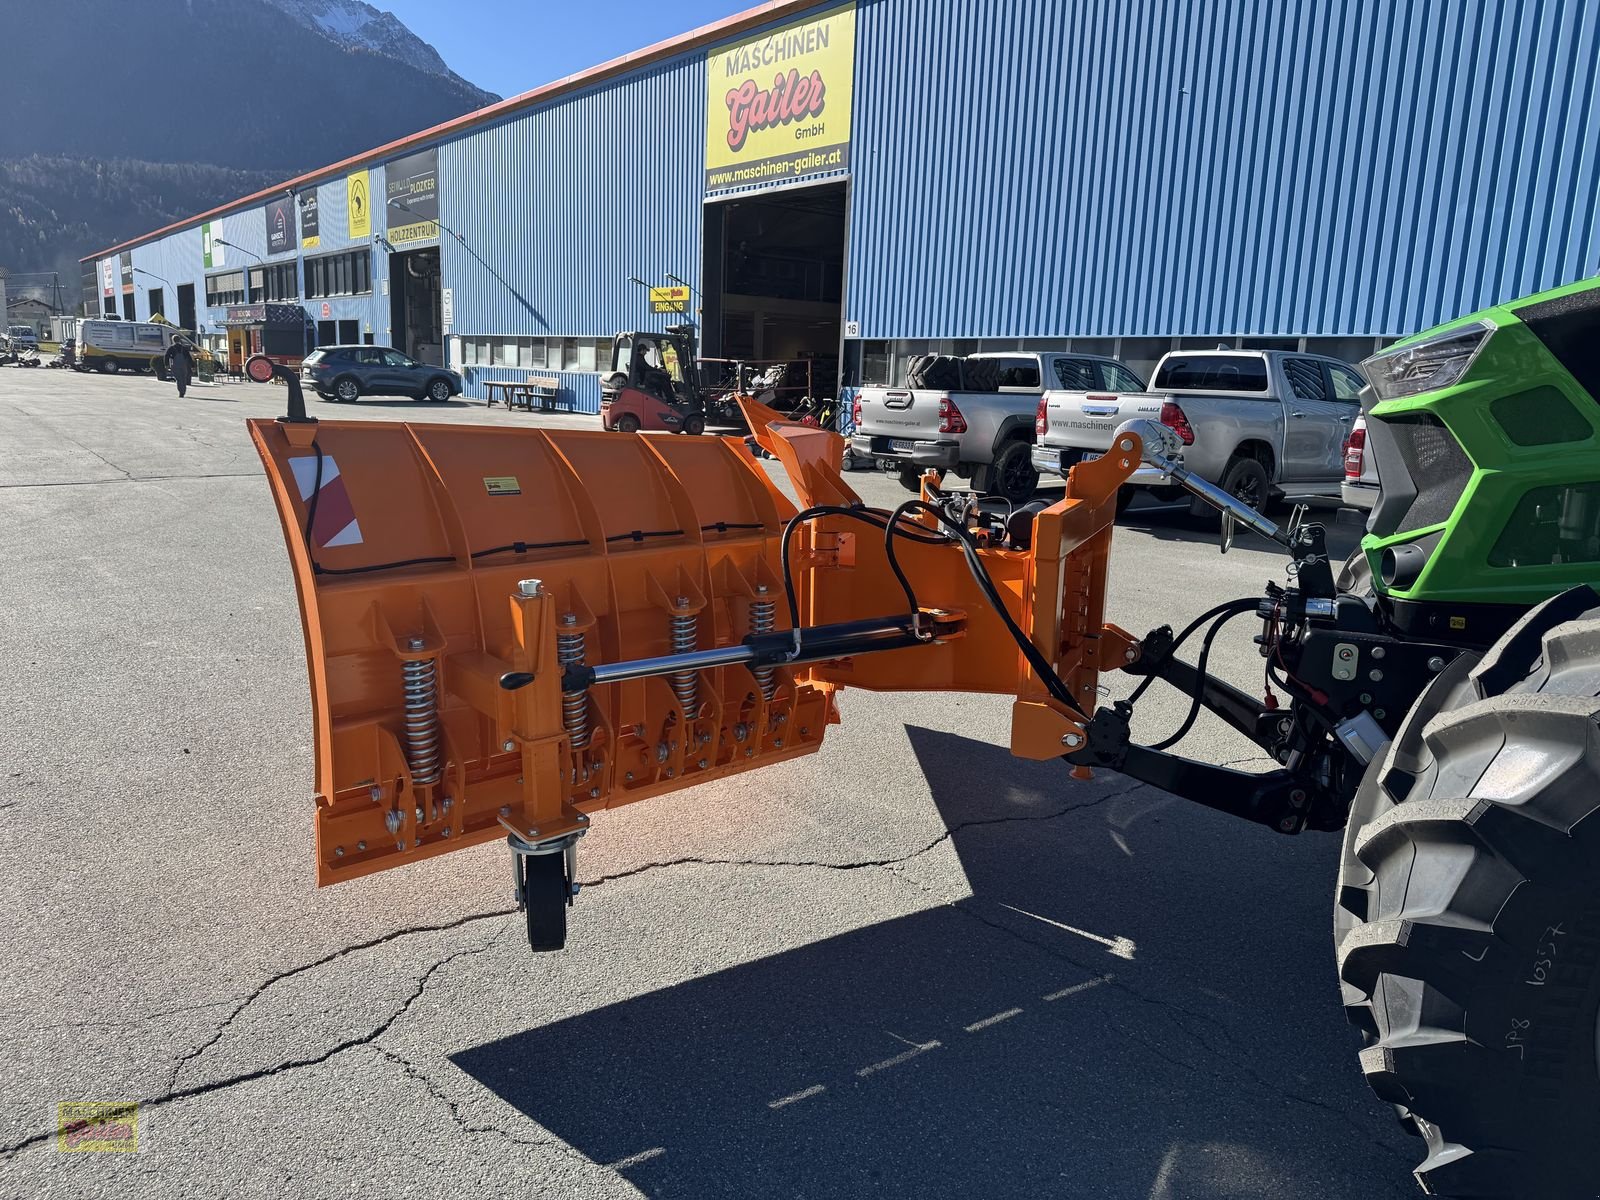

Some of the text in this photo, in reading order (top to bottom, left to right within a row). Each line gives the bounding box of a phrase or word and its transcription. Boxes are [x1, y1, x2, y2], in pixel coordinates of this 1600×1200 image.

[726, 24, 830, 77] MASCHINEN
[725, 68, 826, 152] Gailer
[795, 123, 825, 140] GmbH
[709, 149, 841, 185] www.maschinen-gailer.at
[390, 223, 437, 243] HOLZZENTRUM
[655, 301, 684, 312] EINGANG
[847, 324, 857, 335] 16
